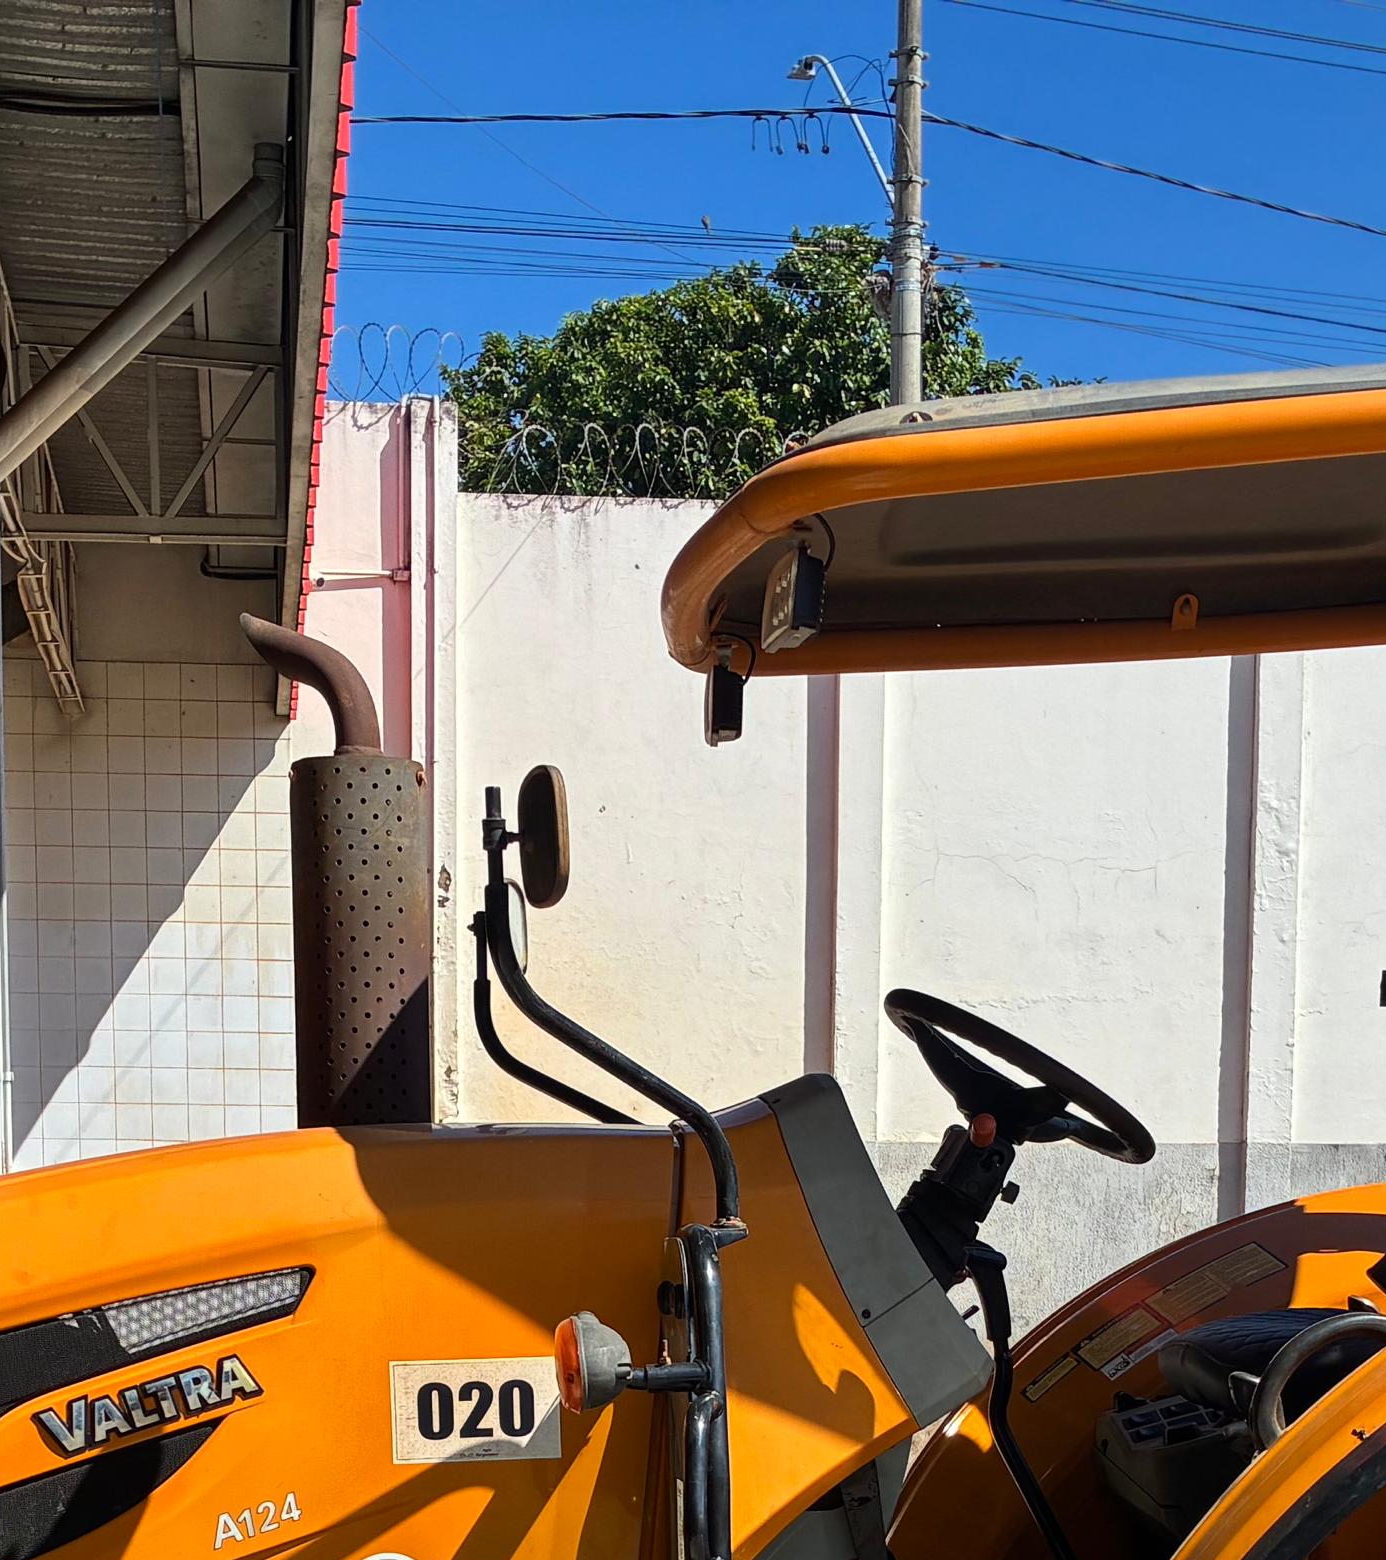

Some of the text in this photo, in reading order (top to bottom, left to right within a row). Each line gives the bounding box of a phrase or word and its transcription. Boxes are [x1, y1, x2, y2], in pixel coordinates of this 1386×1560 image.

[32, 1355, 263, 1453] VALTRA
[417, 1379, 535, 1440] 020
[214, 1492, 302, 1550] A124
